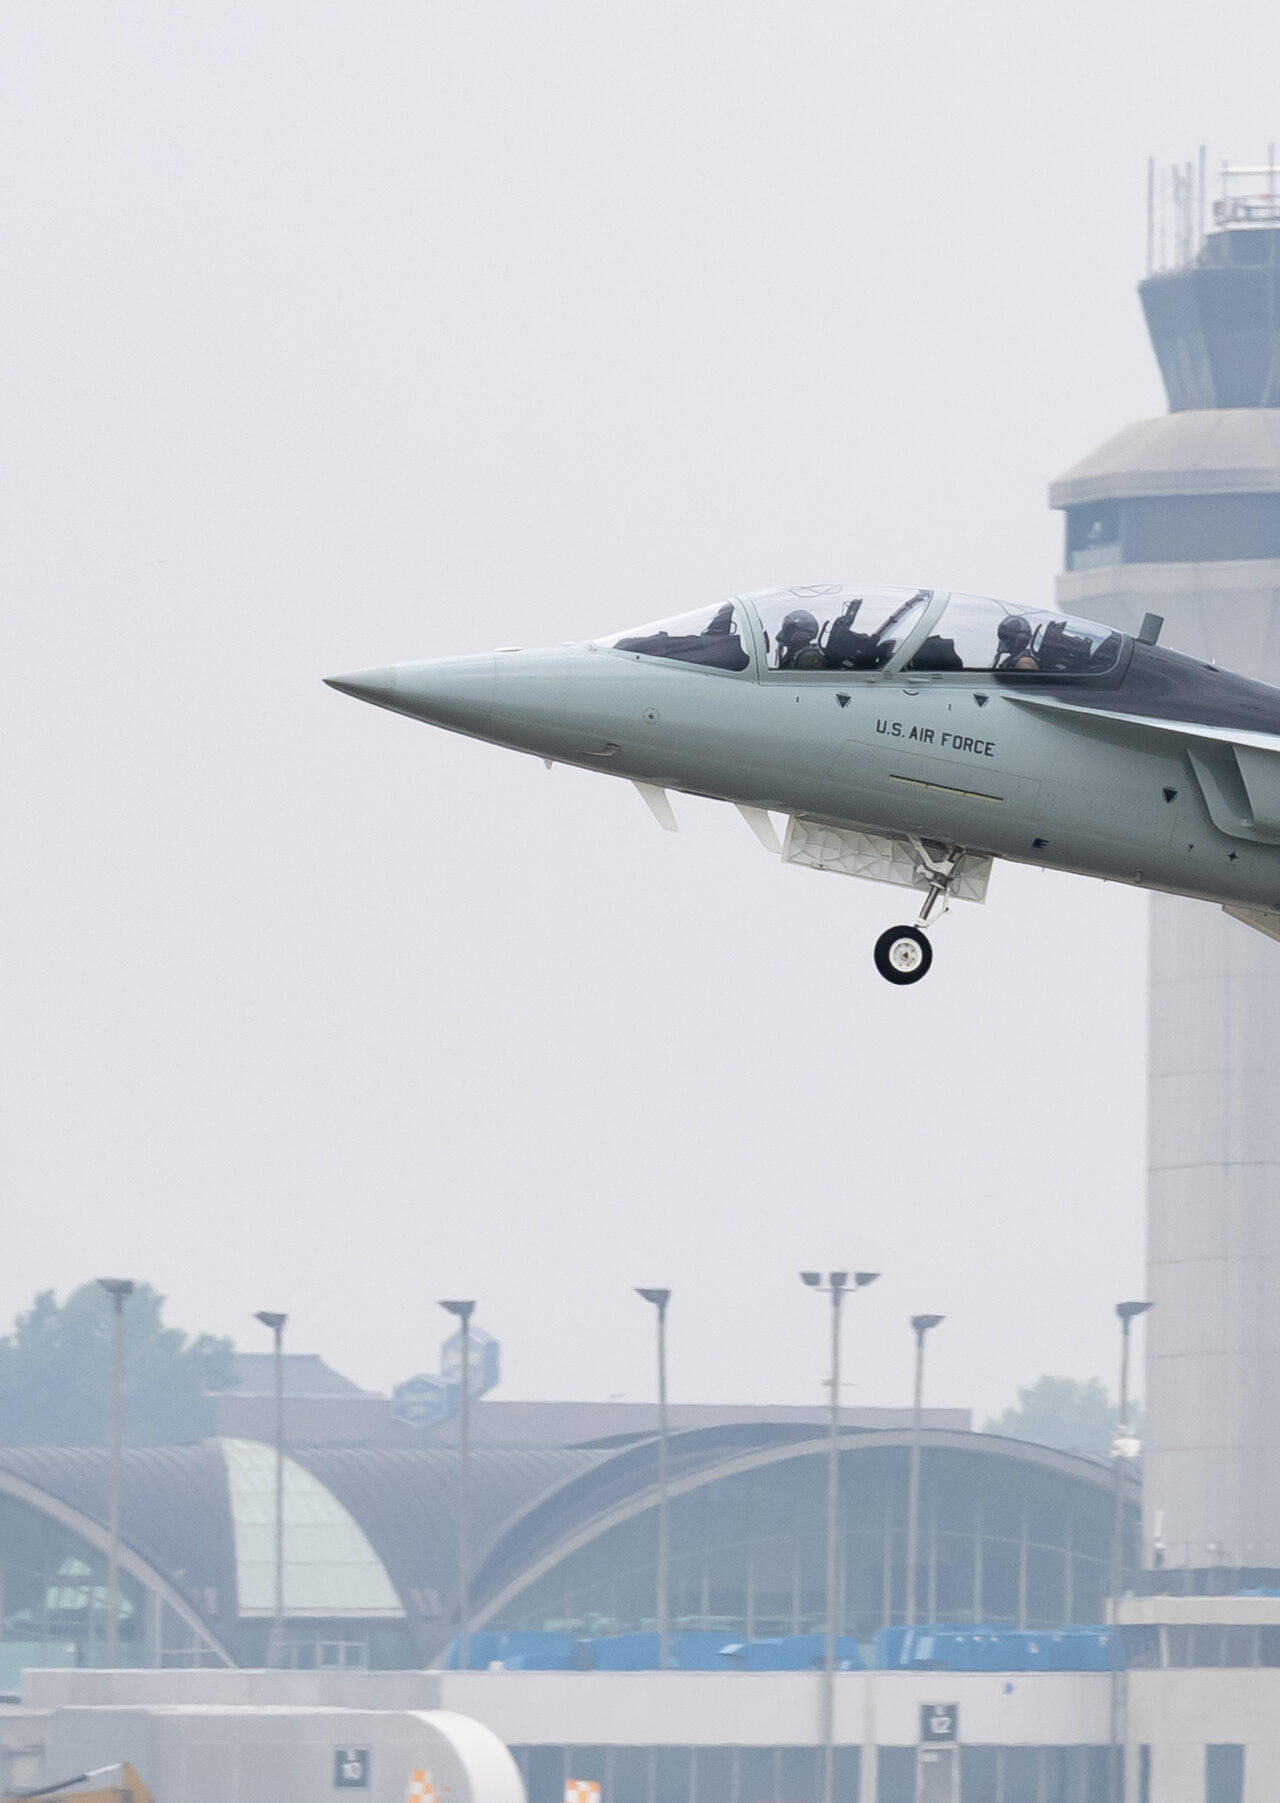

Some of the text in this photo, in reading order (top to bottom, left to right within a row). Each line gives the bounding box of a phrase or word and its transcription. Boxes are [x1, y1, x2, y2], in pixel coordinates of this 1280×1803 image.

[876, 719, 996, 757] U.S. AIR FORCE
[929, 1716, 951, 1734] 12
[341, 1761, 362, 1779] 10
